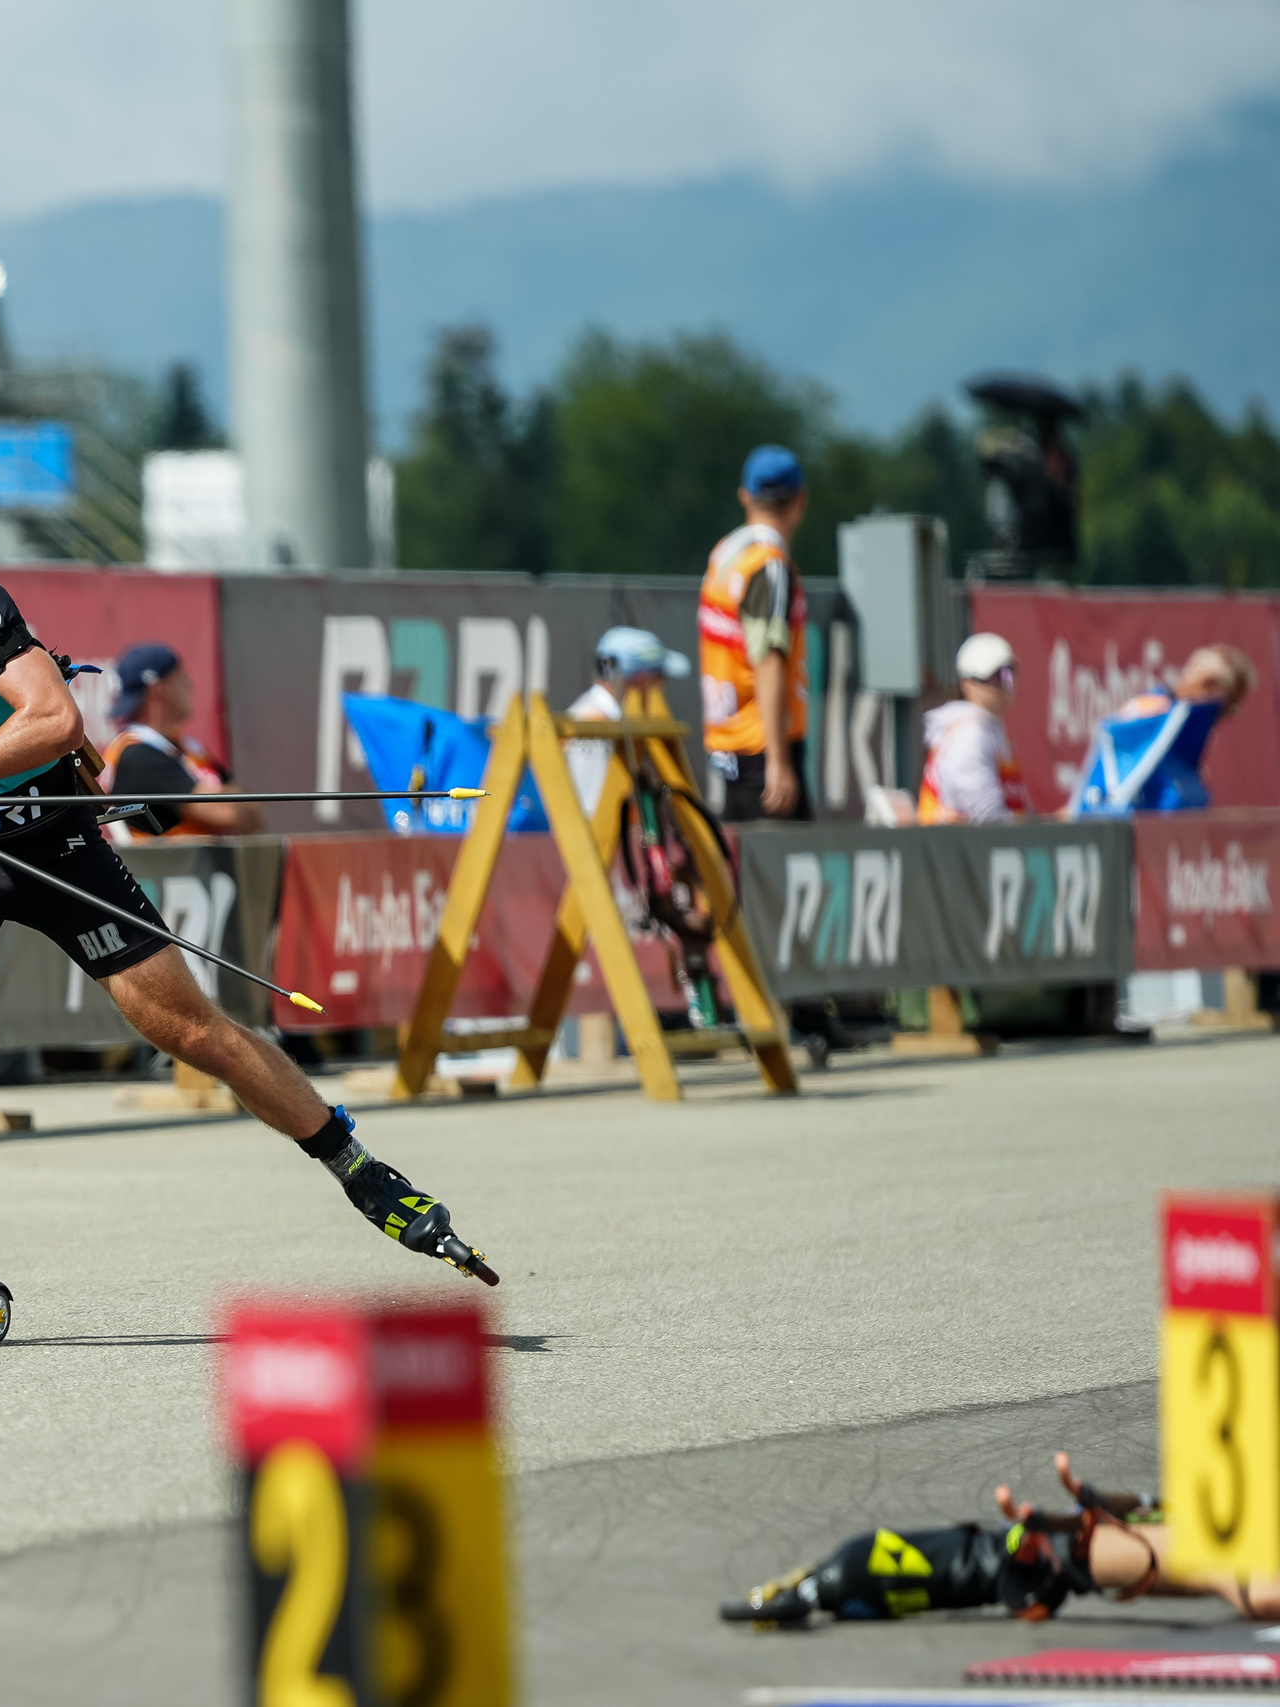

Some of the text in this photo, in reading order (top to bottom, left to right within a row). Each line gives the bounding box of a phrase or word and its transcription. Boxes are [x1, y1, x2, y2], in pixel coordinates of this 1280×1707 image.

[76, 922, 128, 961] BLR
[777, 848, 902, 973] PARI
[984, 842, 1101, 964] PARI
[1196, 1322, 1246, 1546] 3
[248, 1435, 358, 1707] 2
